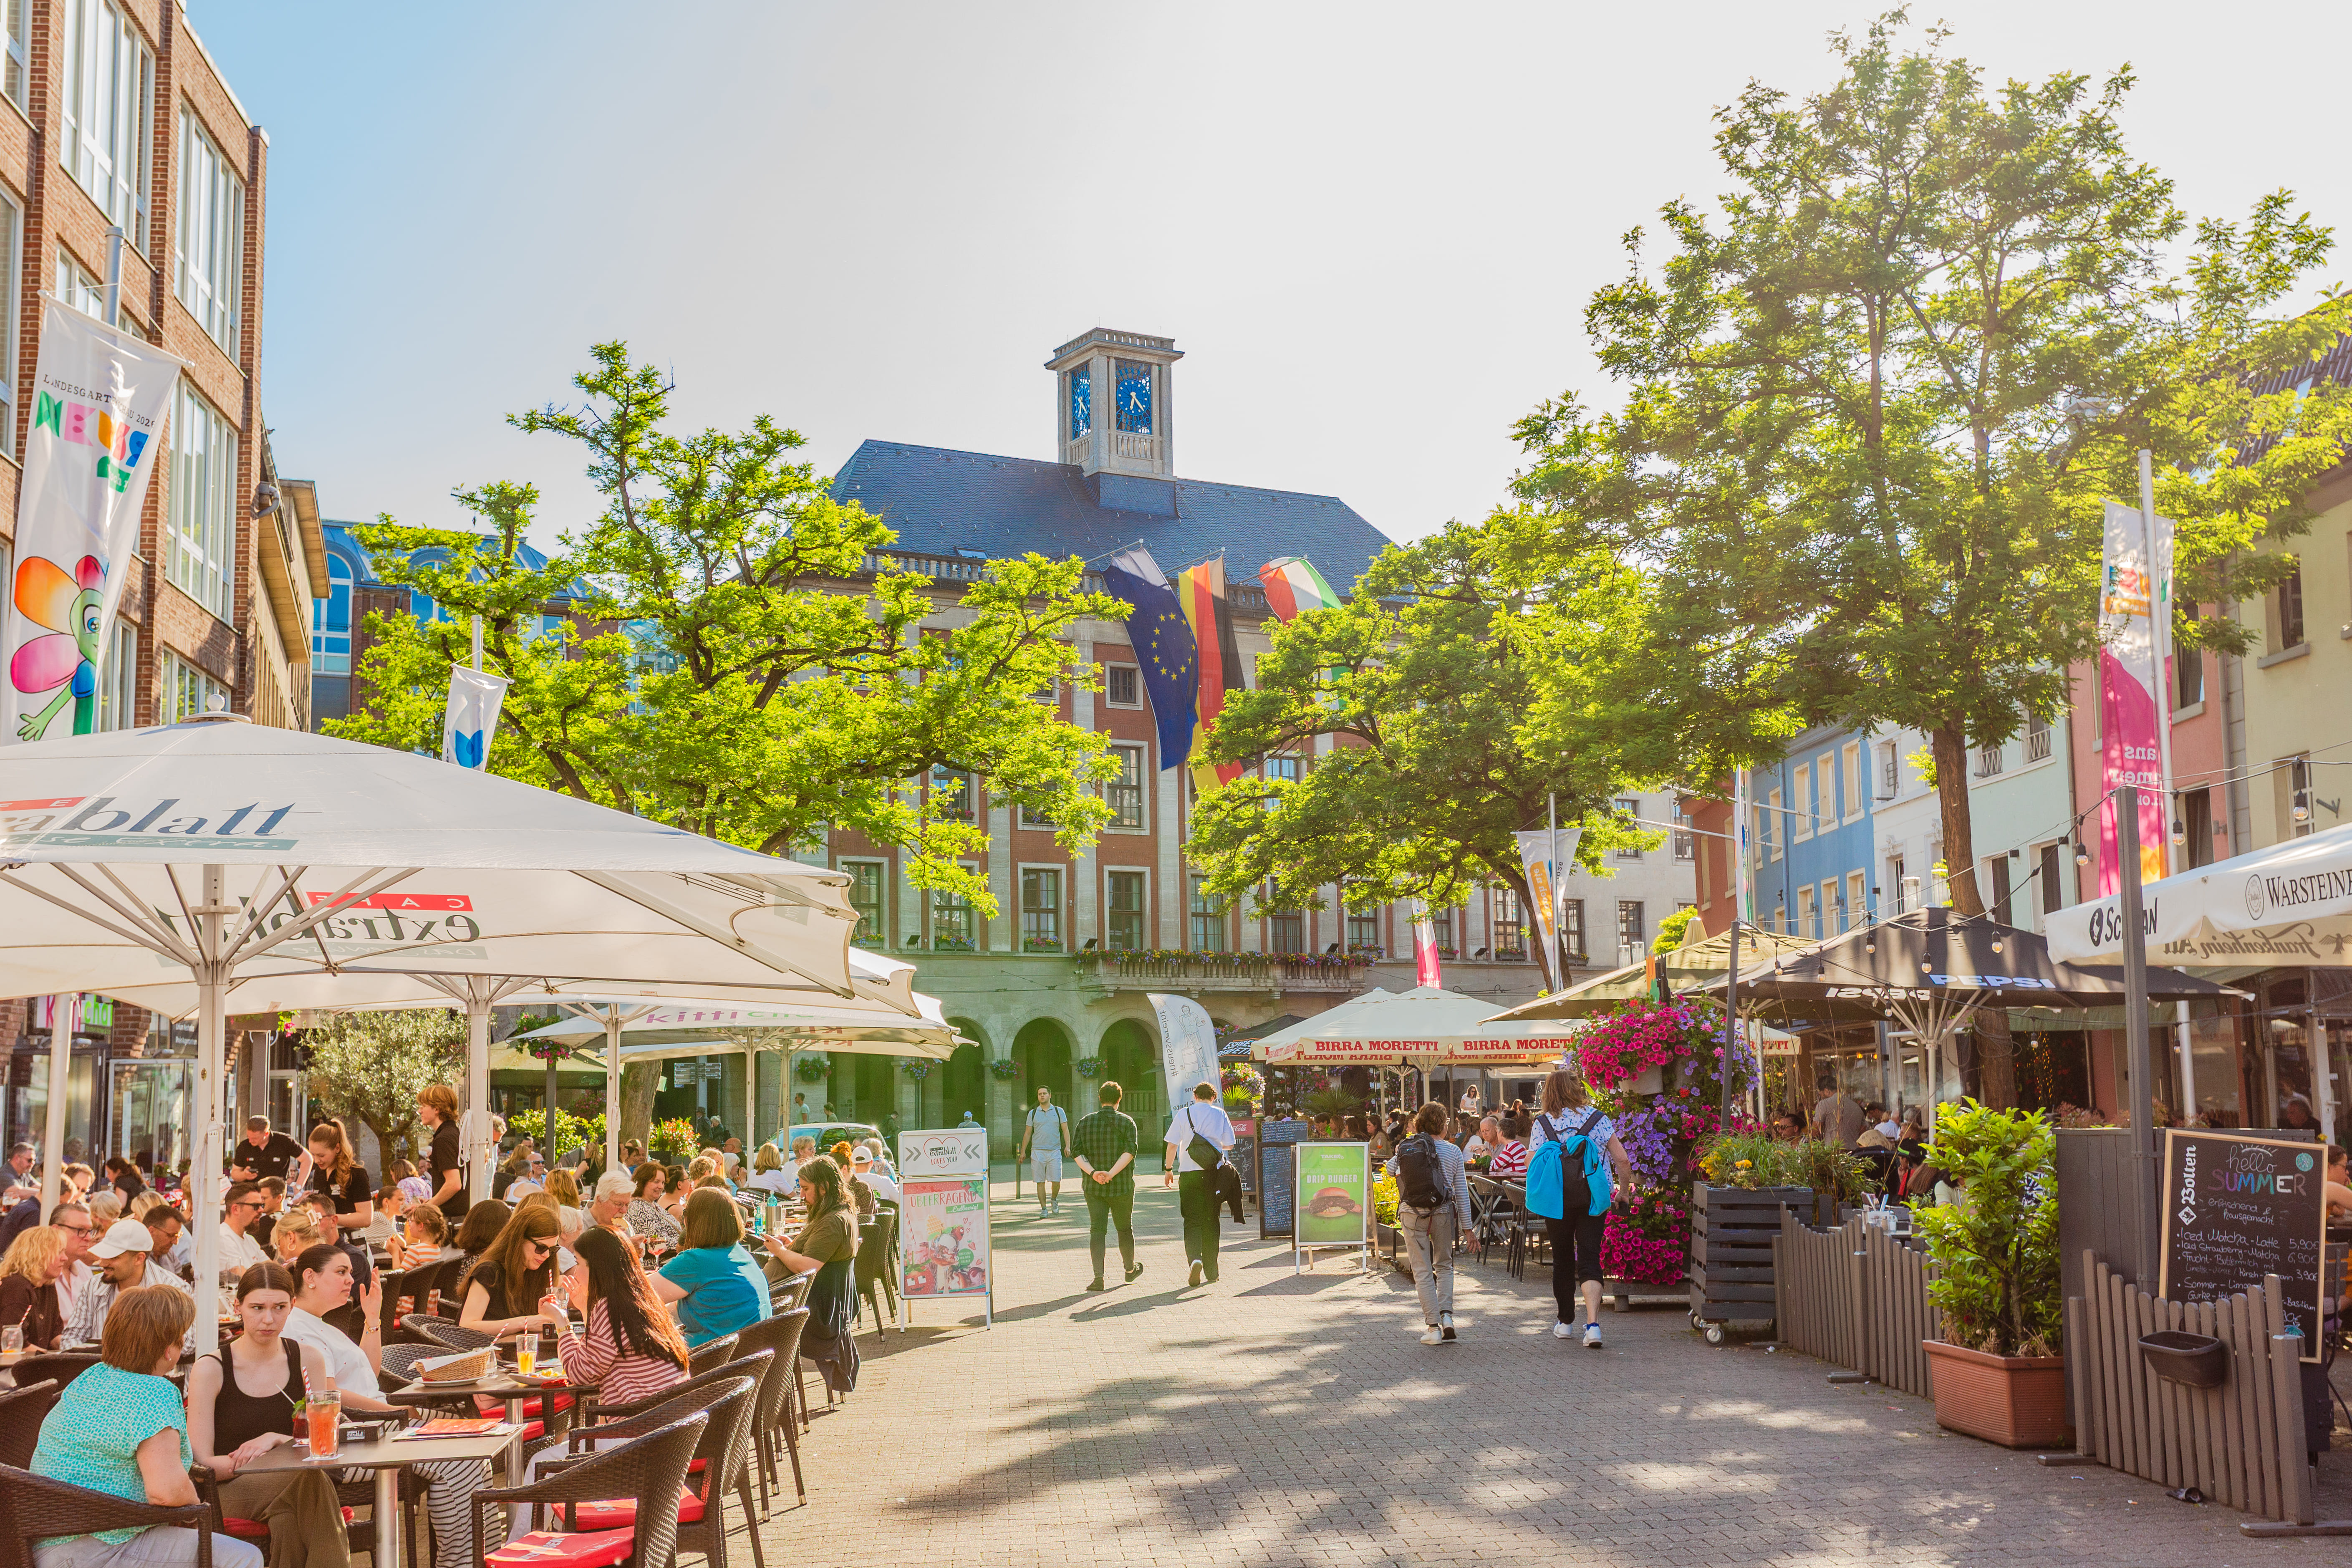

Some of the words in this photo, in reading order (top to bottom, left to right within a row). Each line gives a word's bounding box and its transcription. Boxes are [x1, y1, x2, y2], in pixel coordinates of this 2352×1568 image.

[2266, 869, 2352, 909] WARSTEINE
[1929, 974, 2057, 989] PEPSI
[1315, 1041, 1363, 1051] BIRRA
[1368, 1041, 1438, 1051] MORETTI
[1463, 1040, 1512, 1051] BIRRA
[1516, 1038, 1574, 1050] MORET
[930, 1146, 956, 1156] extrablatt
[2226, 1145, 2277, 1174] hello
[1328, 1174, 1358, 1183] BURGER
[2181, 1145, 2196, 1205] Bolten
[2208, 1169, 2307, 1197] SUMMER
[910, 1191, 977, 1207] ÜBEERRAGEND
[2208, 1198, 2257, 1213] erfrischend
[2223, 1208, 2274, 1225] hausgemacht
[2184, 1277, 2217, 1288] Sommer
